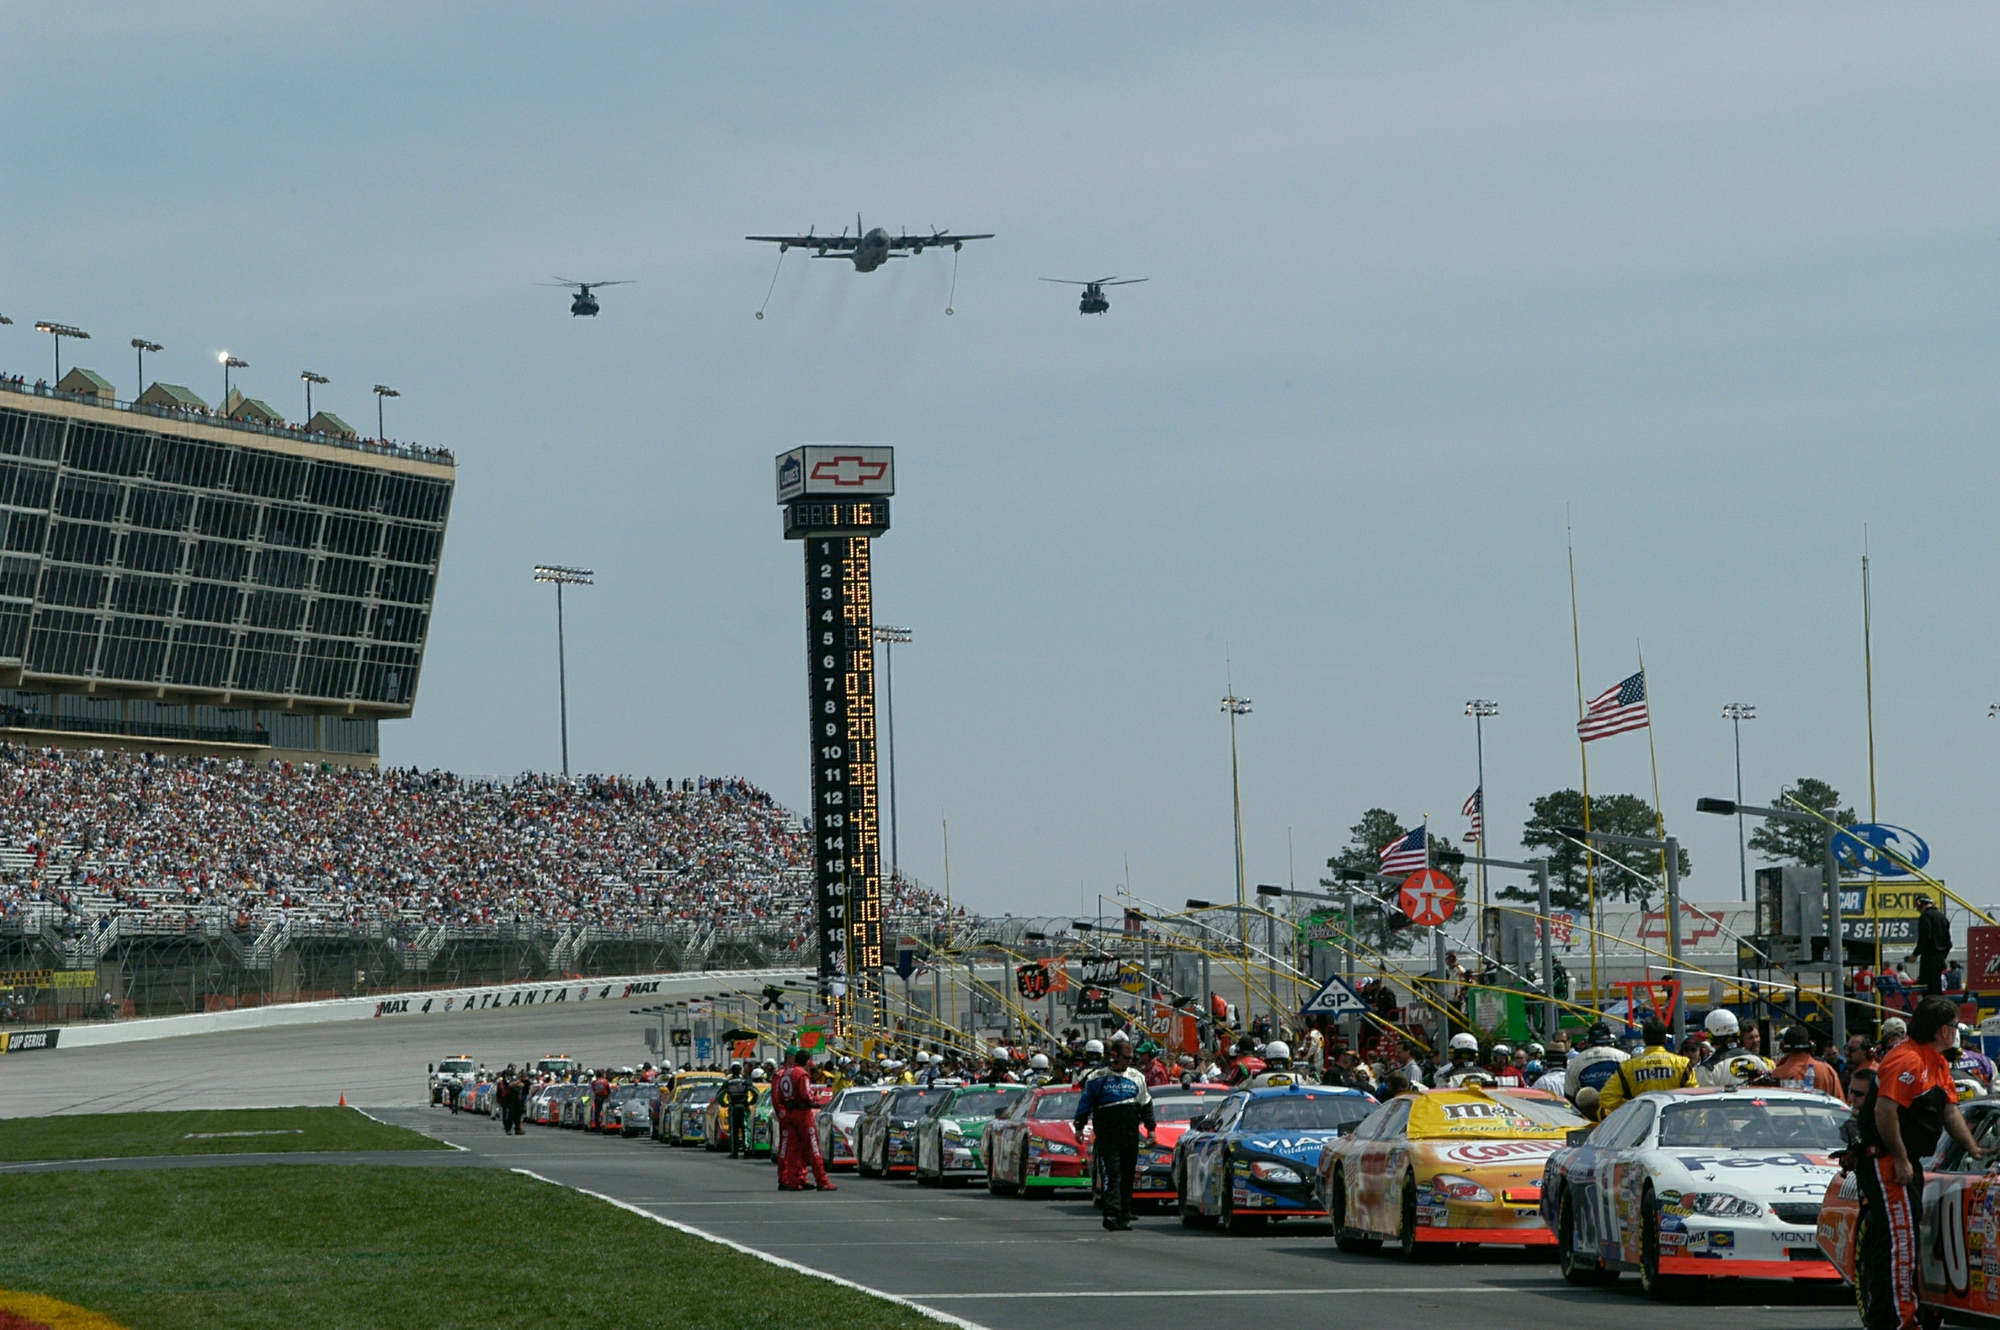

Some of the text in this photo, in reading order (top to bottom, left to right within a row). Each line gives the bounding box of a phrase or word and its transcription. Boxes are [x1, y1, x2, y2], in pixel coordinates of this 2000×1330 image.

[821, 542, 830, 555] 1
[820, 564, 832, 578] 2
[821, 587, 832, 600] 3
[821, 610, 833, 622] 4
[822, 632, 834, 645] 5
[823, 655, 835, 668] 6
[824, 678, 835, 691] 7
[824, 700, 836, 714] 8
[825, 723, 837, 736] 9
[822, 746, 842, 759] 10
[824, 769, 841, 782] 11
[824, 791, 843, 805] 12
[824, 814, 844, 827] 13
[824, 836, 845, 850] 14
[826, 860, 845, 873] 15
[826, 882, 846, 896] 16
[827, 905, 845, 918] 17
[827, 928, 847, 942] 18
[1822, 922, 1909, 939] CP SERIES
[421, 998, 433, 1013] 4
[463, 987, 568, 1011] ATLANTA
[599, 985, 612, 999] 4
[1321, 993, 1350, 1008] GP
[9, 1033, 48, 1050] CUP SERIES
[1898, 1071, 1916, 1085] 20
[1457, 1184, 1480, 1198] 38
[1706, 1195, 1734, 1211] 11
[1515, 1208, 1539, 1217] TA
[1662, 1204, 1694, 1217] MOOG
[1687, 1231, 1706, 1244] WIX
[1771, 1231, 1815, 1243] MONT
